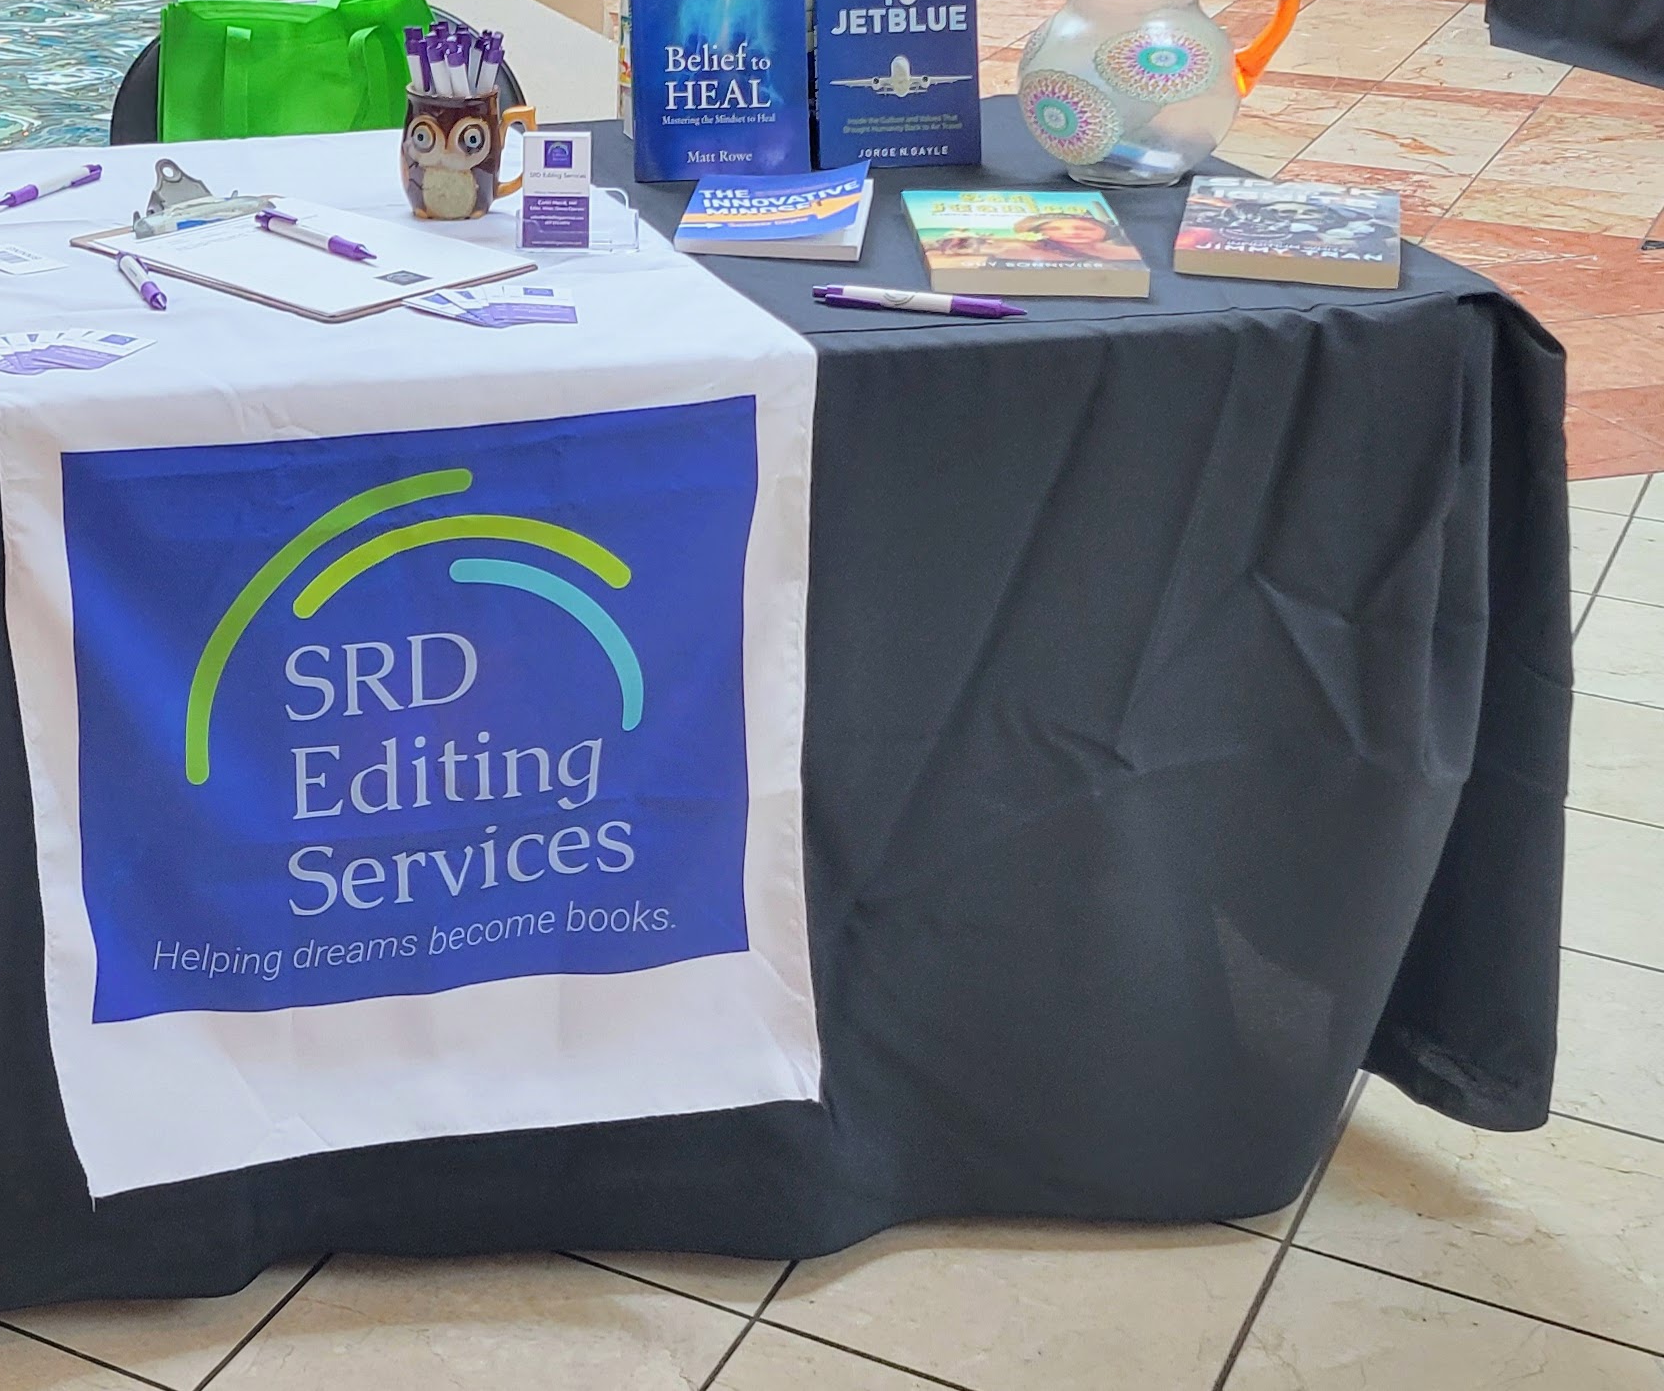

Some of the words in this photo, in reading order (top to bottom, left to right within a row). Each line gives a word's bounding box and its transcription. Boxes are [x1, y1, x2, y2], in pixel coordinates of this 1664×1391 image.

[831, 5, 968, 35] JETBLUE
[664, 43, 748, 72] Belief
[751, 55, 771, 71] to
[664, 79, 772, 110] HEAL
[662, 115, 700, 126] Mastering
[701, 114, 714, 124] the
[715, 113, 746, 124] Mindset
[747, 115, 756, 123] to
[757, 113, 776, 123] Heal
[687, 150, 716, 164] Matt
[719, 150, 753, 162] Rowe
[858, 147, 896, 158] JORGE
[910, 145, 949, 156] GAYLE
[699, 189, 751, 198] THE
[703, 180, 860, 208] INNOVATIVE
[1195, 241, 1290, 256] JIMMY
[1299, 249, 1383, 261] TRAN
[284, 632, 478, 721] SRD
[290, 731, 603, 820] Editing
[288, 821, 635, 916] Services
[152, 940, 283, 981] Helping
[292, 934, 418, 970] dreams
[428, 909, 555, 956] become
[566, 901, 677, 934] books.
